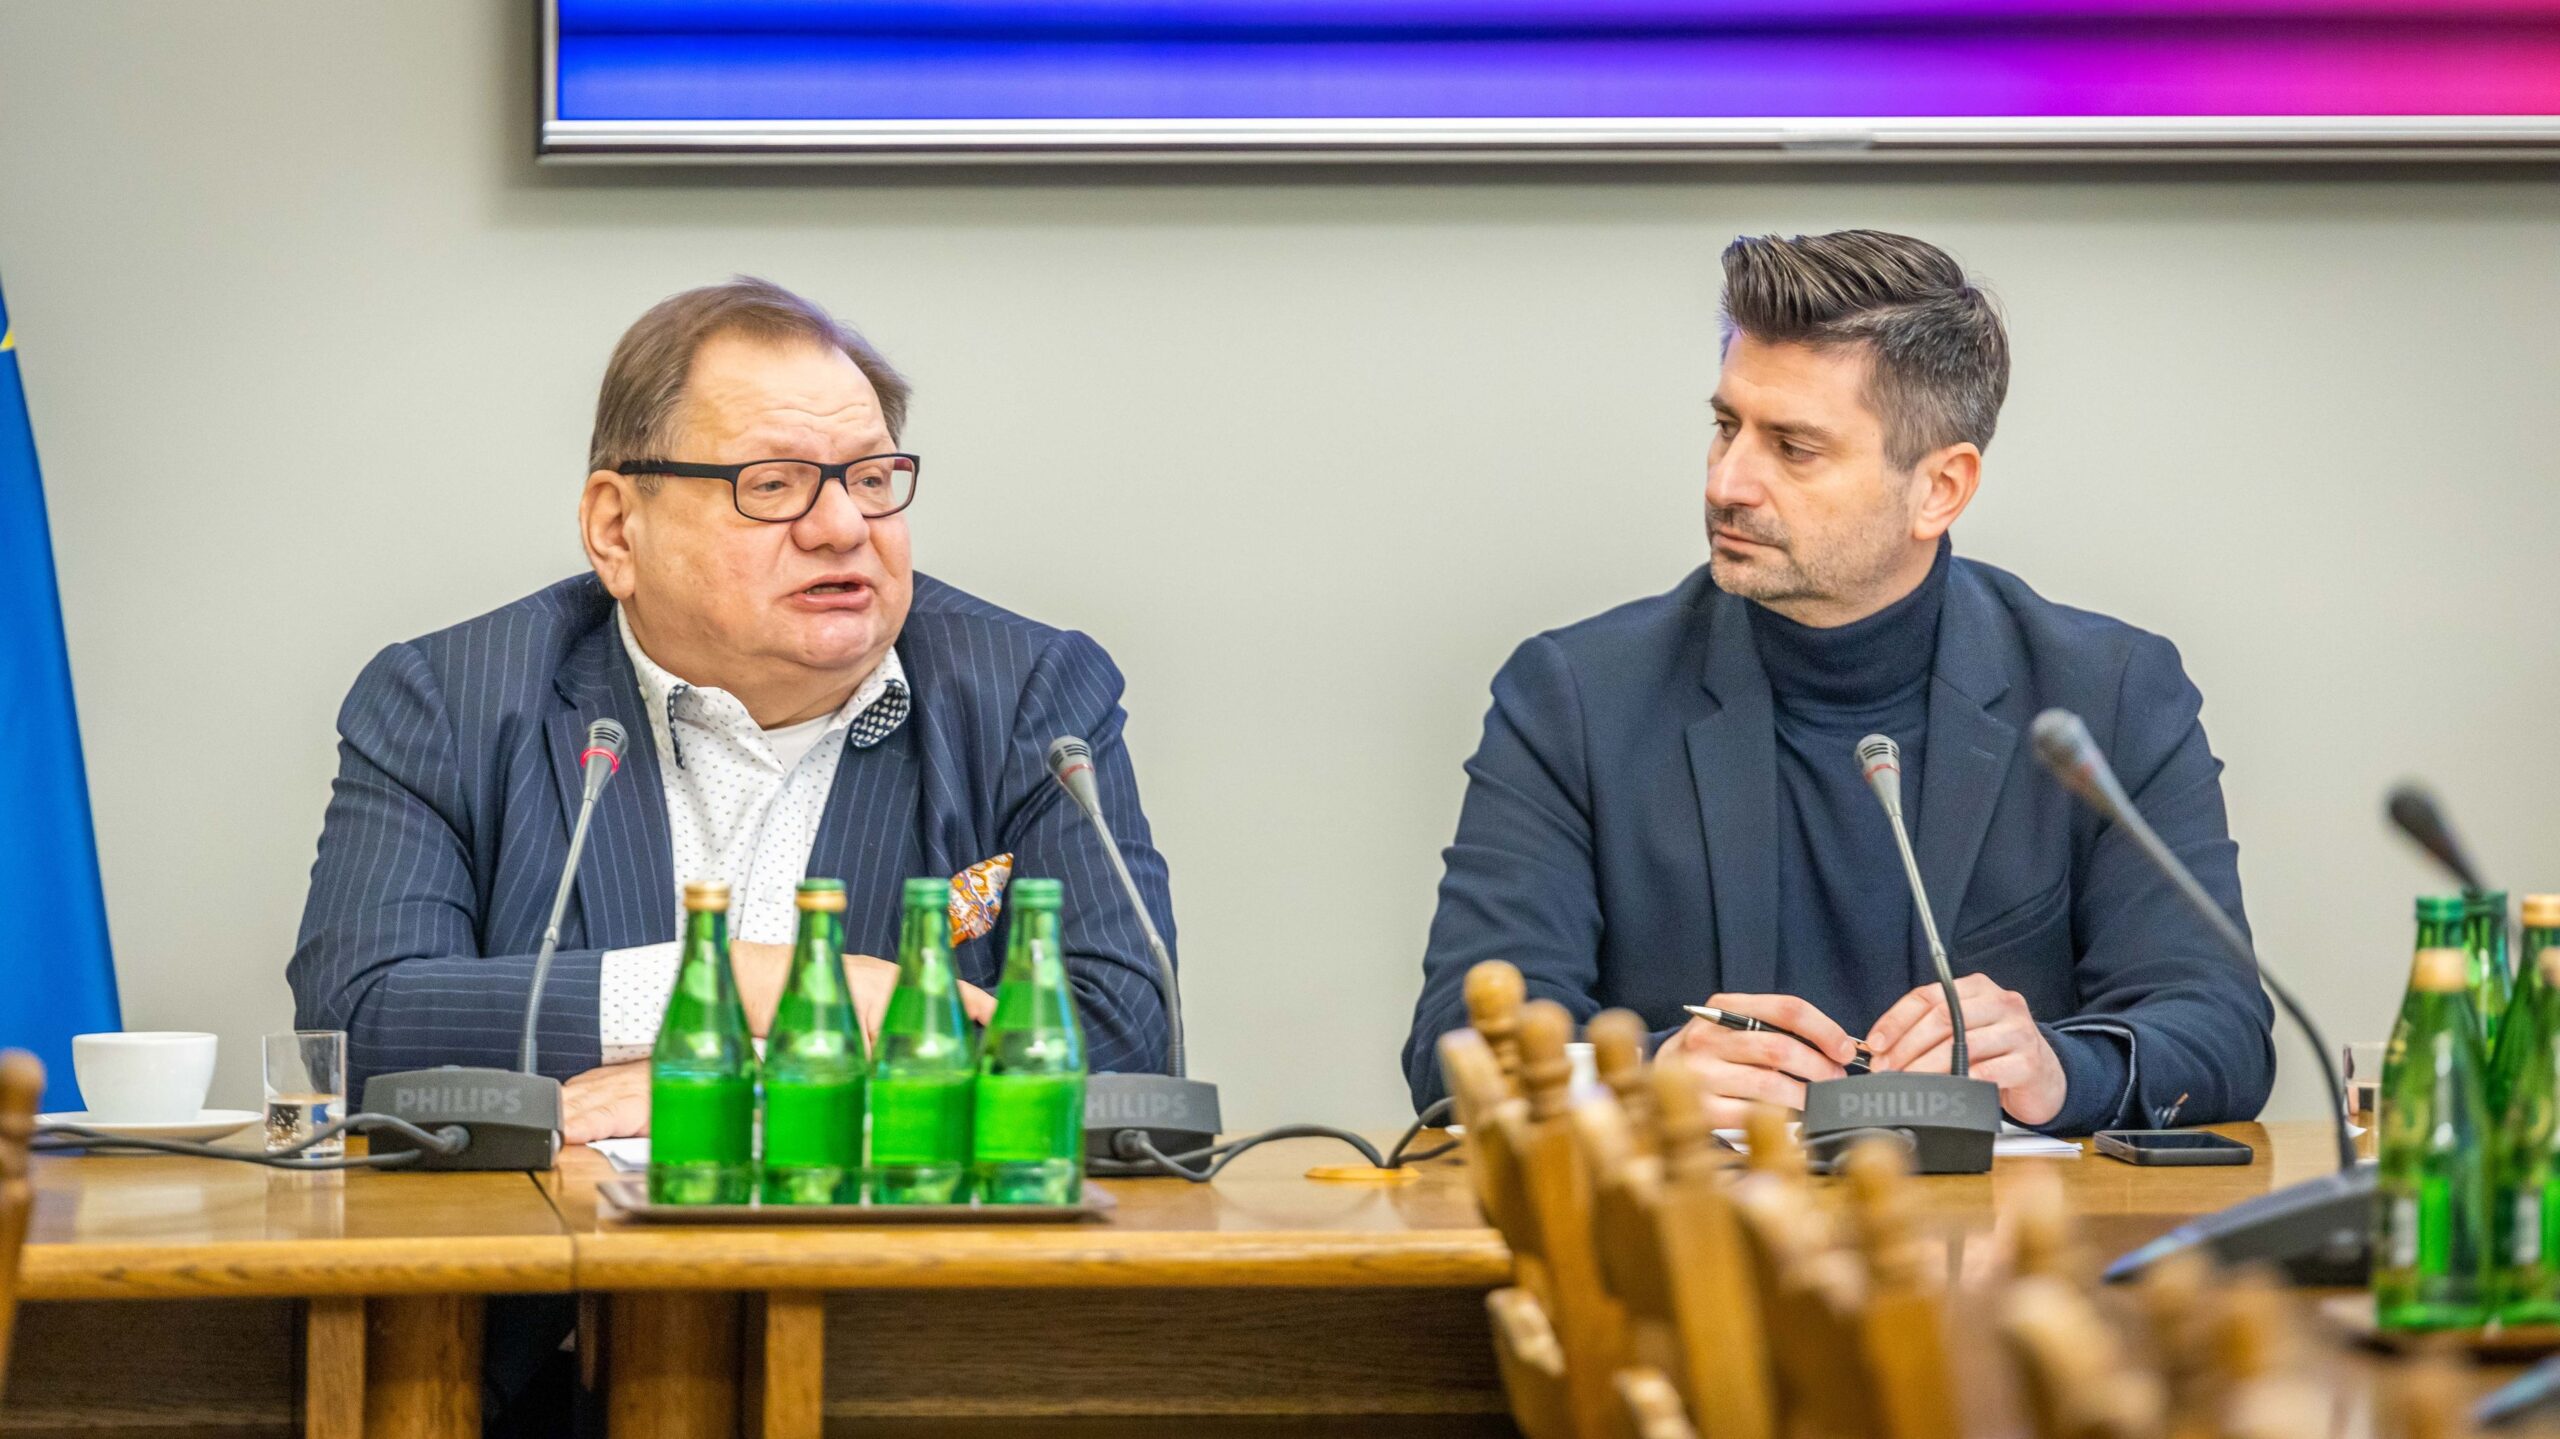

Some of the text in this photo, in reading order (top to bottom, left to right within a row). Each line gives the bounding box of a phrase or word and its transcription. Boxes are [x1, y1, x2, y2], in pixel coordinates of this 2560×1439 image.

[395, 1087, 521, 1113] PHILIPS
[1086, 1092, 1189, 1118] HILIPS
[1839, 1090, 1967, 1116] PHILIPS
